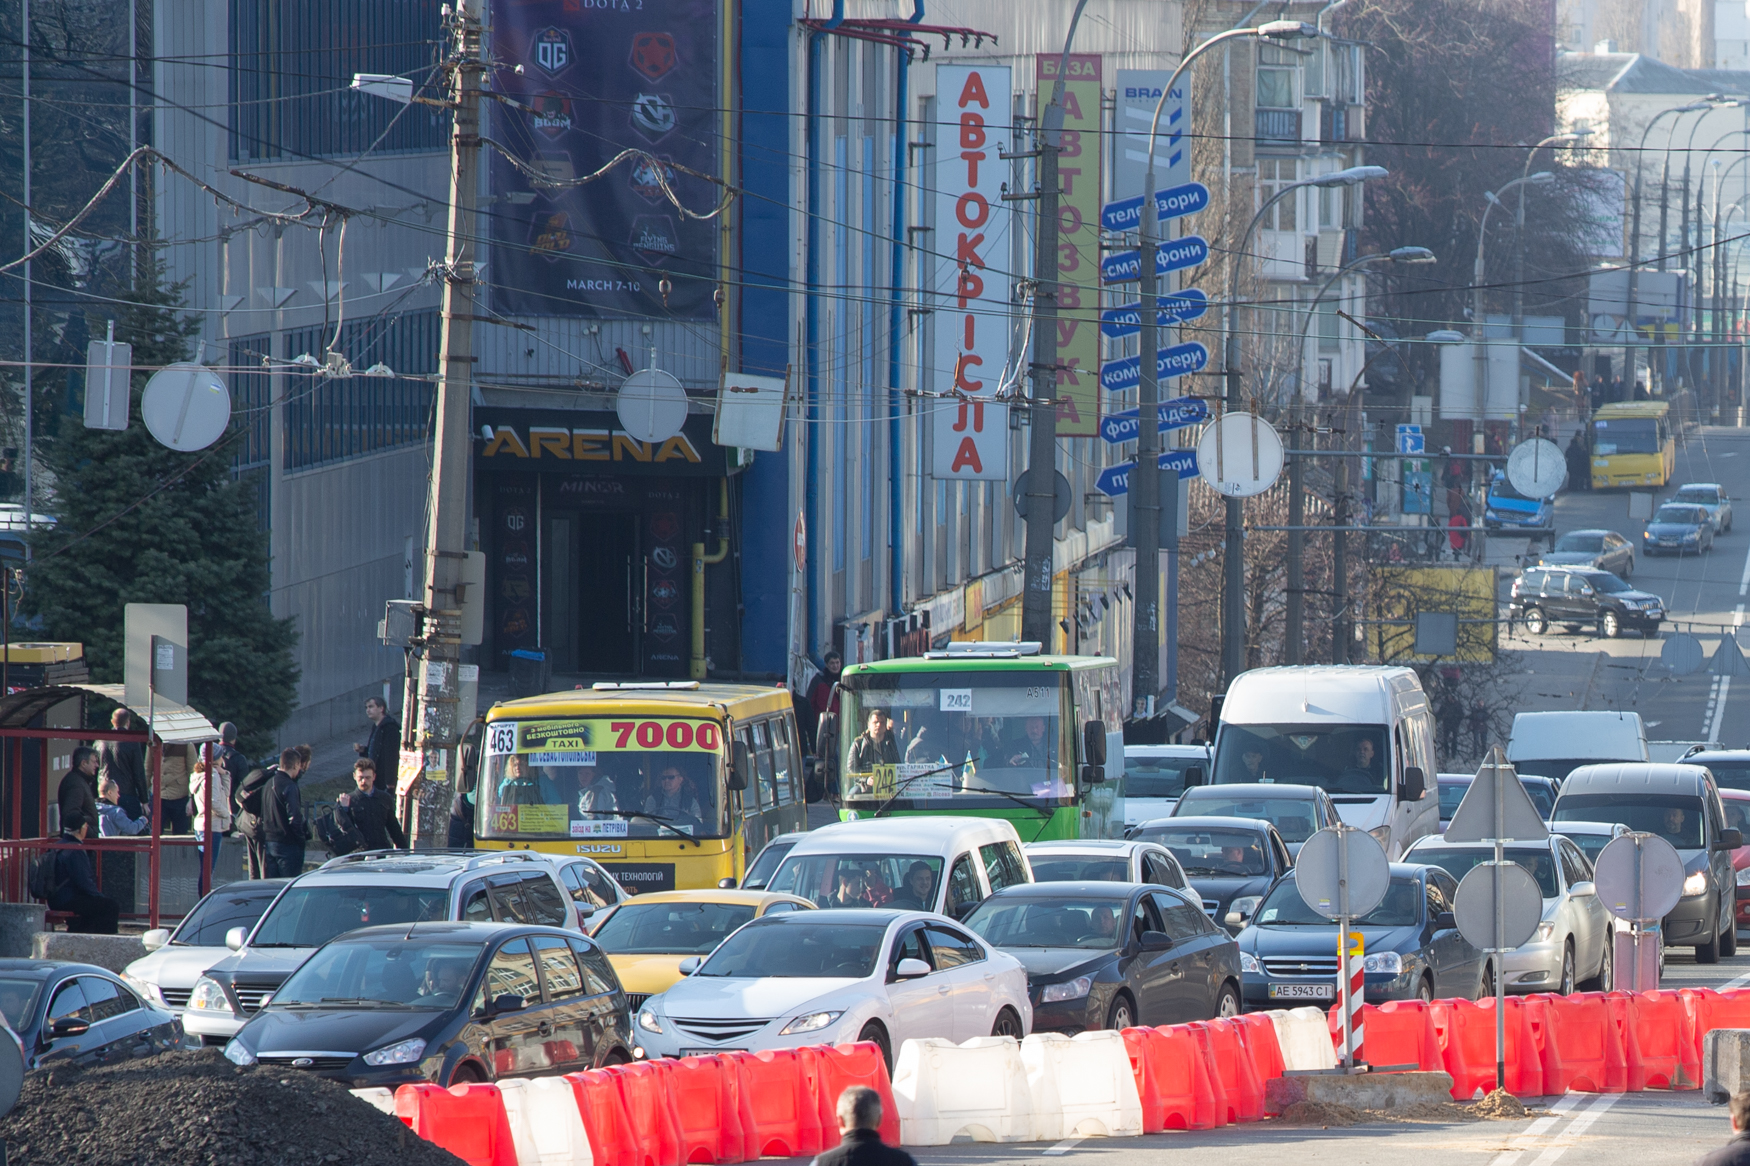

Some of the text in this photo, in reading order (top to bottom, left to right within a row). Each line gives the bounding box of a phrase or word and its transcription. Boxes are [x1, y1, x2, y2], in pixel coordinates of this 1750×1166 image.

[1042, 60, 1096, 76] БАЗА
[1125, 87, 1182, 99] BRAN
[952, 71, 990, 474] АВТОКРІСЛА
[567, 279, 640, 292] MARCH 7-10
[482, 425, 702, 463] ARENA
[947, 687, 1050, 708] 242 A511
[490, 729, 514, 753] 463
[526, 727, 585, 741] БЕЗКОШТОВНО
[611, 721, 722, 750] 7000
[875, 769, 894, 793] 242
[490, 812, 517, 831] 463
[585, 825, 591, 833] на
[602, 822, 627, 834] ПЕТРІВКА
[577, 845, 621, 853] ISUZU
[621, 870, 664, 881] ТЕХНОЛОГІЙ
[1276, 986, 1328, 996] AE 5943 CI
